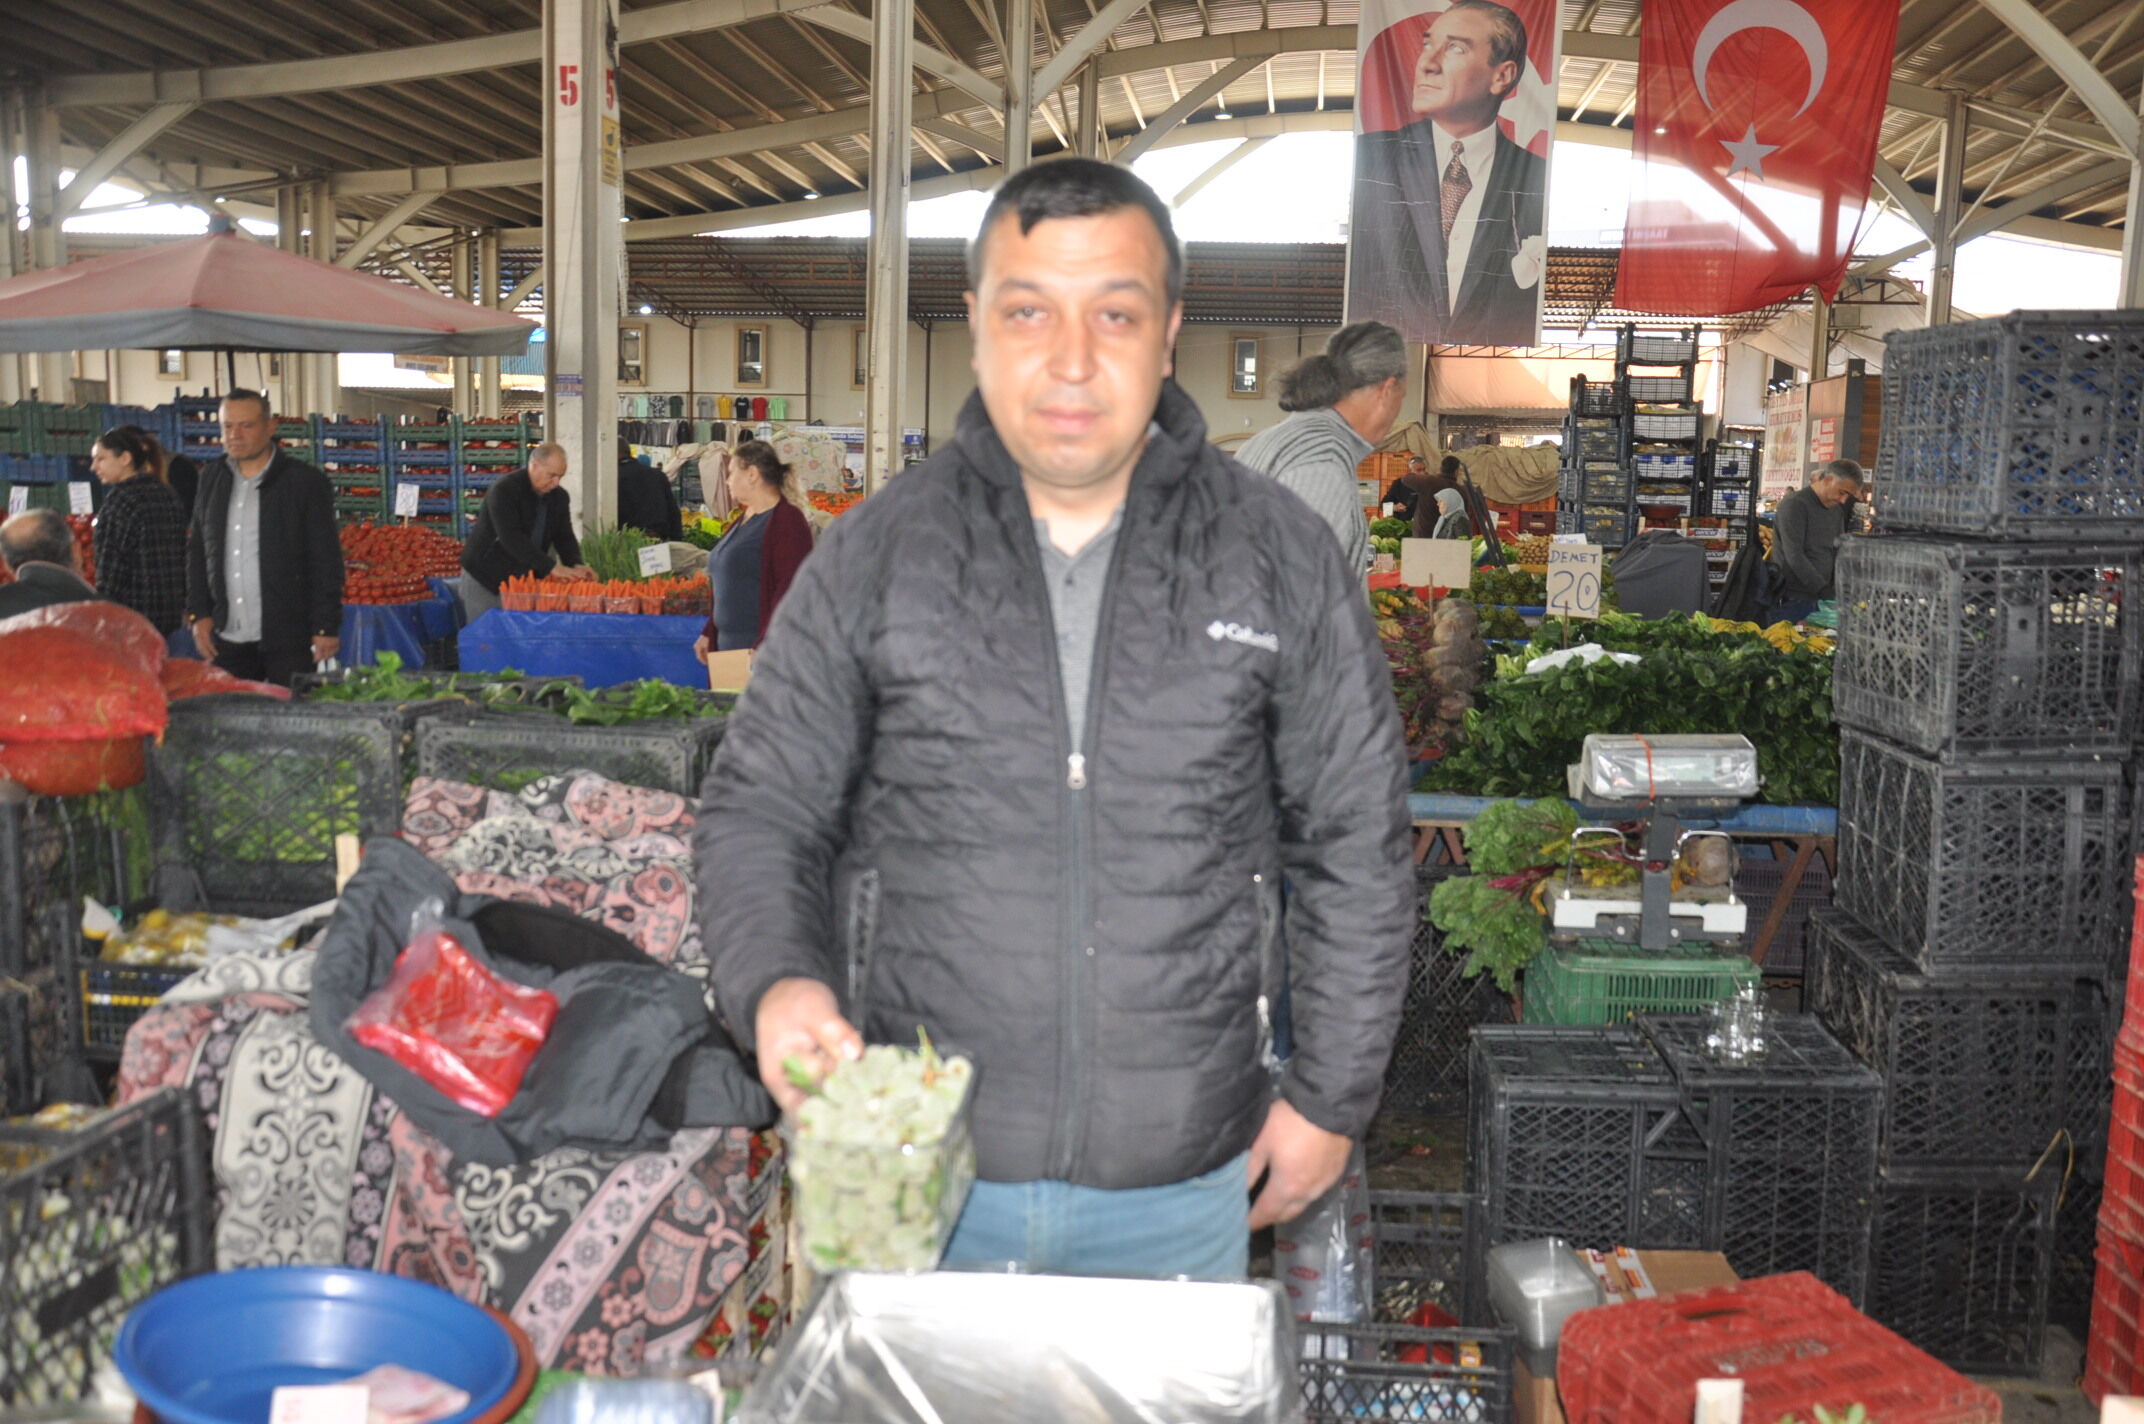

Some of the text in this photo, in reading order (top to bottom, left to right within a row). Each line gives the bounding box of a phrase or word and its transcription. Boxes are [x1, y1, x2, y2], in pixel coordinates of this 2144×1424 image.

[559, 65, 578, 106] 5
[605, 69, 616, 110] 5
[1548, 550, 1599, 563] DEMET
[1551, 570, 1600, 611] 20
